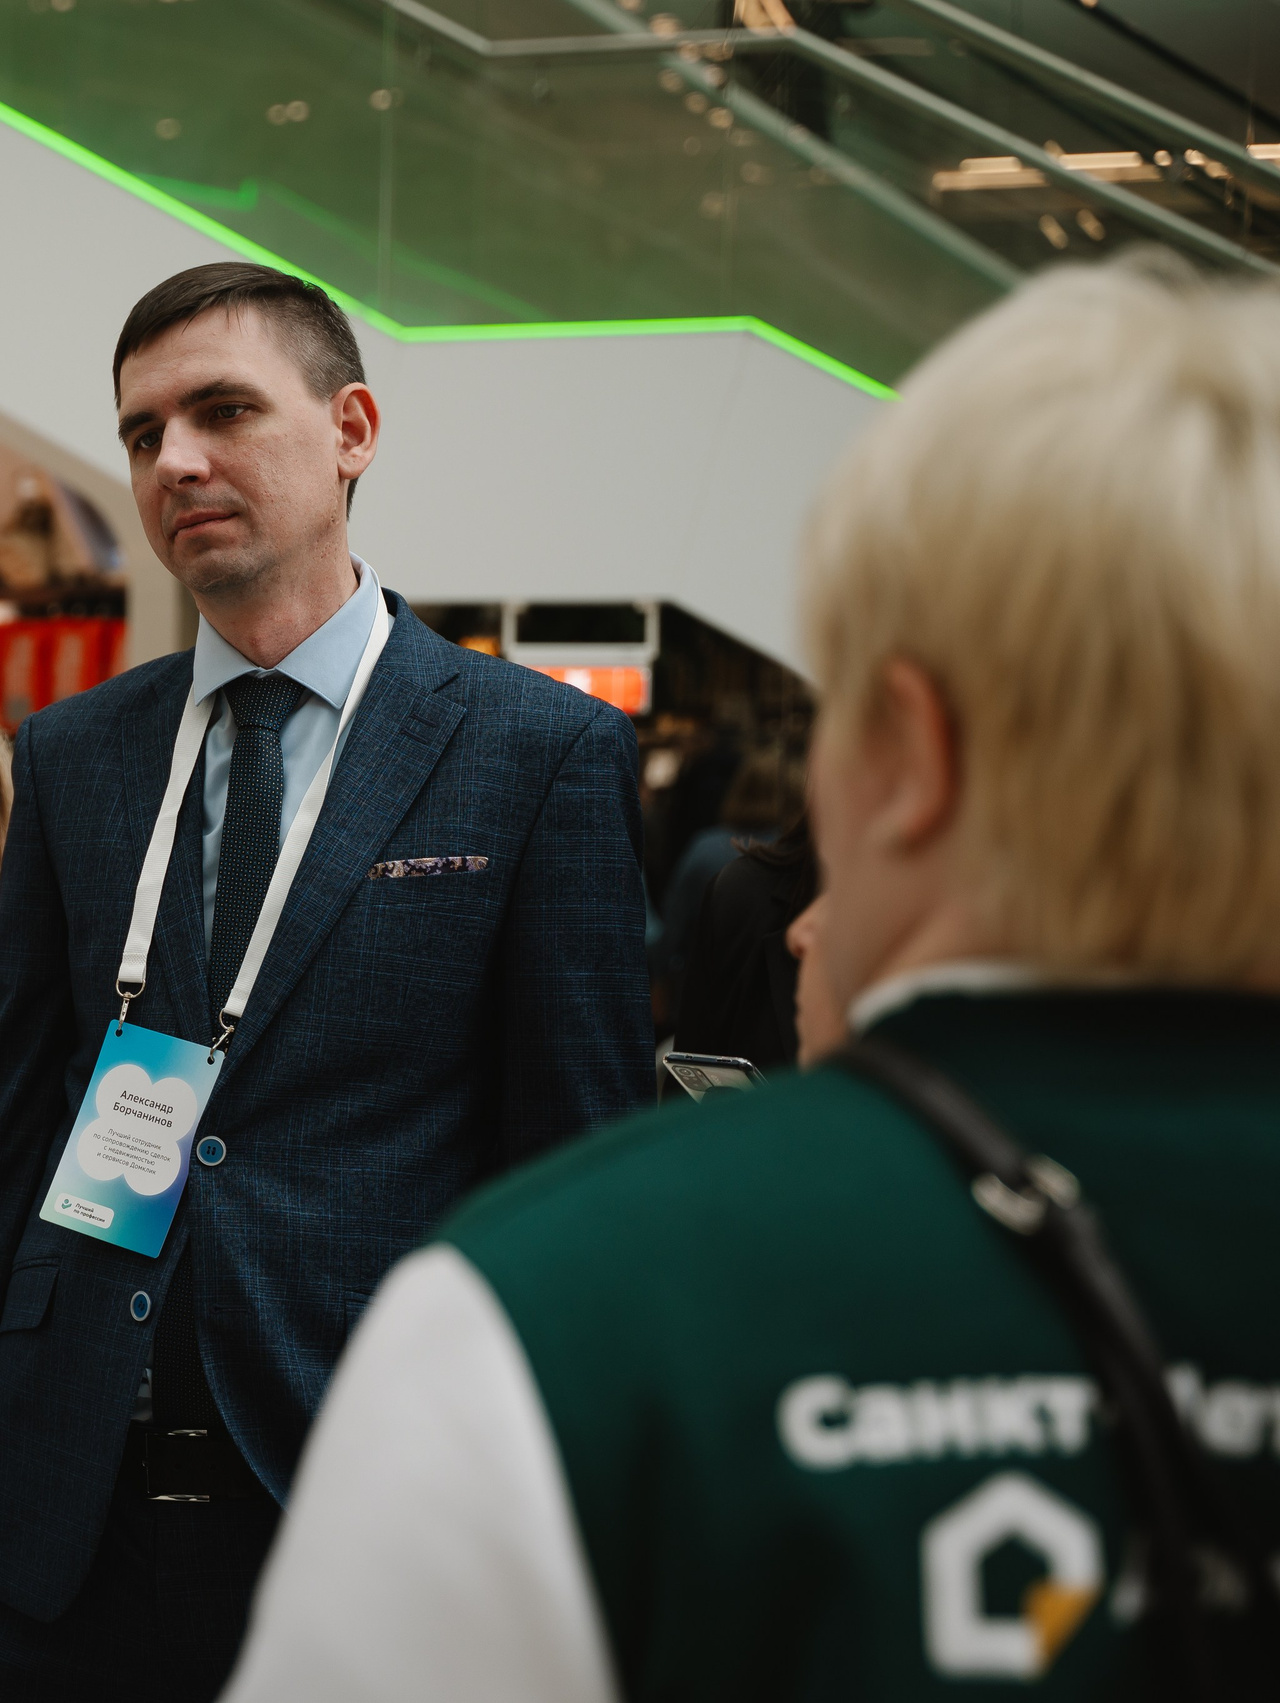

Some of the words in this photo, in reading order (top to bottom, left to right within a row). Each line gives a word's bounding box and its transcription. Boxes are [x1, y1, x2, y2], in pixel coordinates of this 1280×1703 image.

[120, 1090, 174, 1114] Александр
[112, 1102, 173, 1128] Борчанинов
[101, 1135, 150, 1156] сопровождению
[150, 1149, 171, 1162] сделок
[107, 1128, 131, 1141] Лучший
[131, 1136, 162, 1151] сотрудник
[102, 1153, 130, 1167] сервисов
[129, 1160, 157, 1175] Домклик
[107, 1146, 156, 1166] недвижимостью
